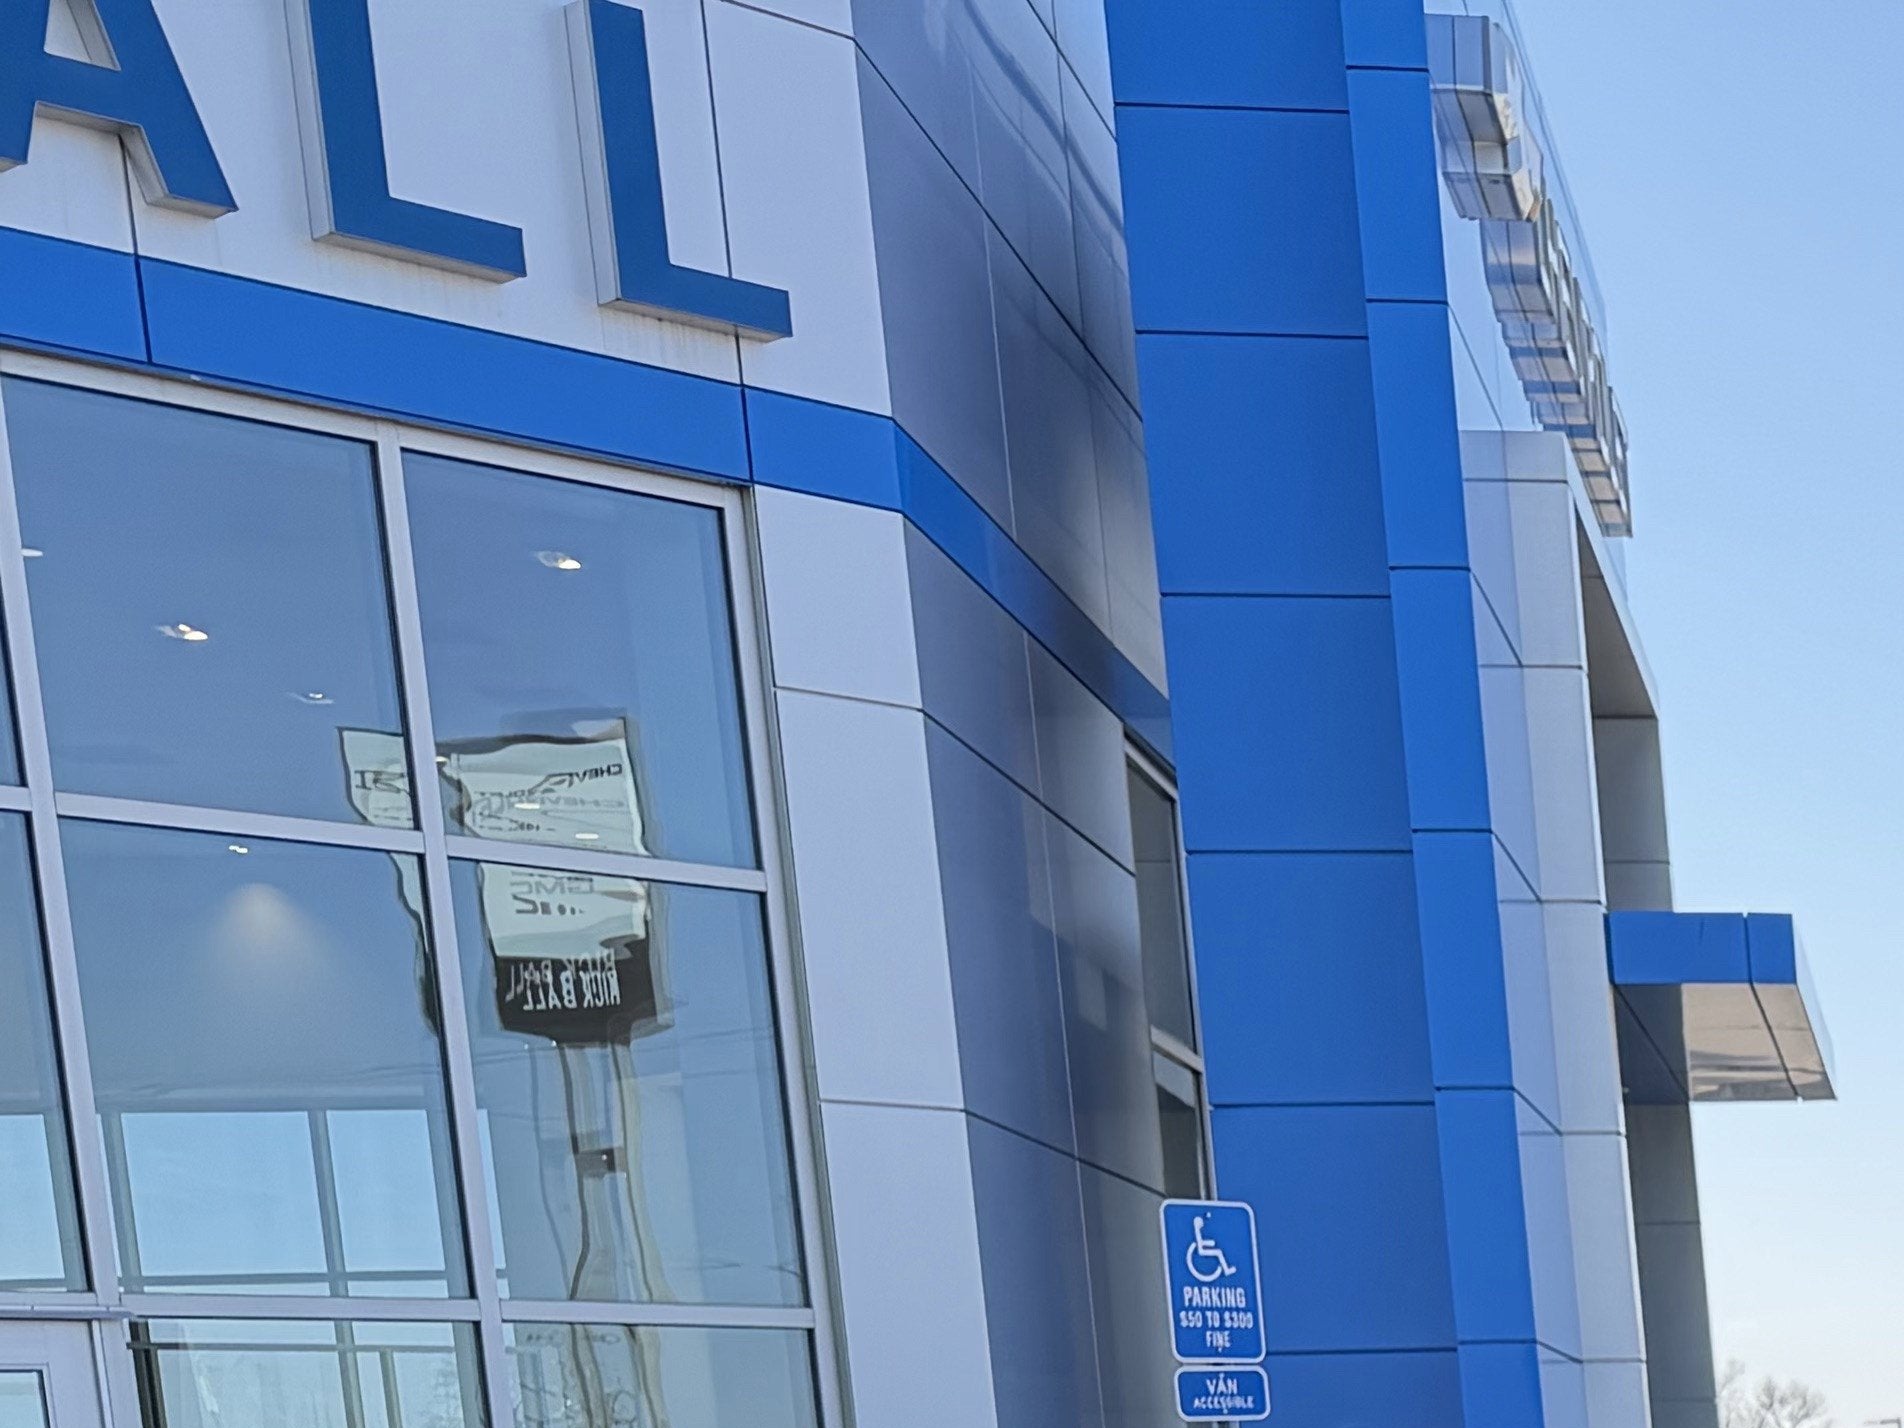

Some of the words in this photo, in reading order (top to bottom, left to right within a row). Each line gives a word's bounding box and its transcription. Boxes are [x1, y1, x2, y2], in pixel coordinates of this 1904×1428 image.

[1183, 1286, 1246, 1308] PARKING
[1180, 1310, 1203, 1328] $50
[1205, 1311, 1220, 1328] TO
[1224, 1311, 1254, 1329] $300
[1206, 1331, 1231, 1348] FINE
[1206, 1378, 1238, 1395] VAN
